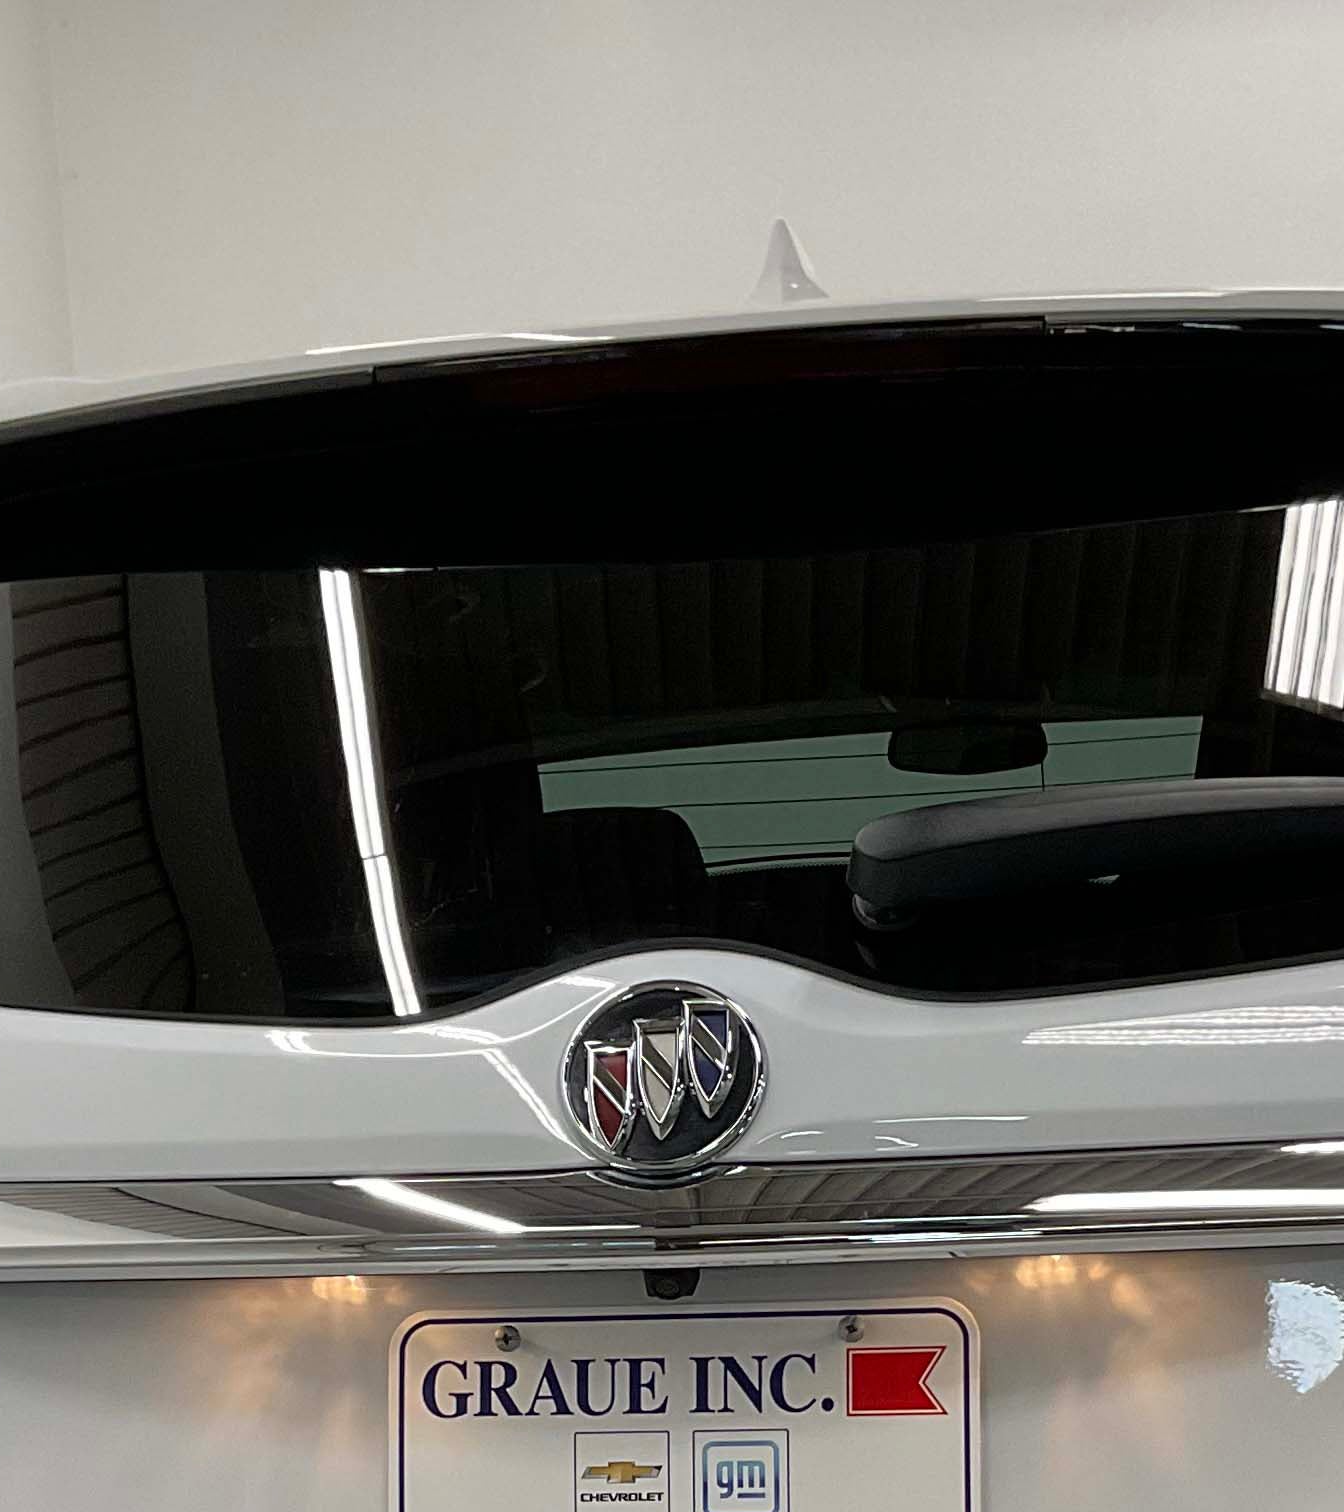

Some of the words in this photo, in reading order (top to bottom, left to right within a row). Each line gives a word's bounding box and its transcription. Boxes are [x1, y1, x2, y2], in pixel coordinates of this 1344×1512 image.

[422, 1358, 669, 1419] GRAUE
[688, 1353, 836, 1414] INC.
[579, 1491, 665, 1503] CHEVROLET
[716, 1460, 766, 1499] gm
